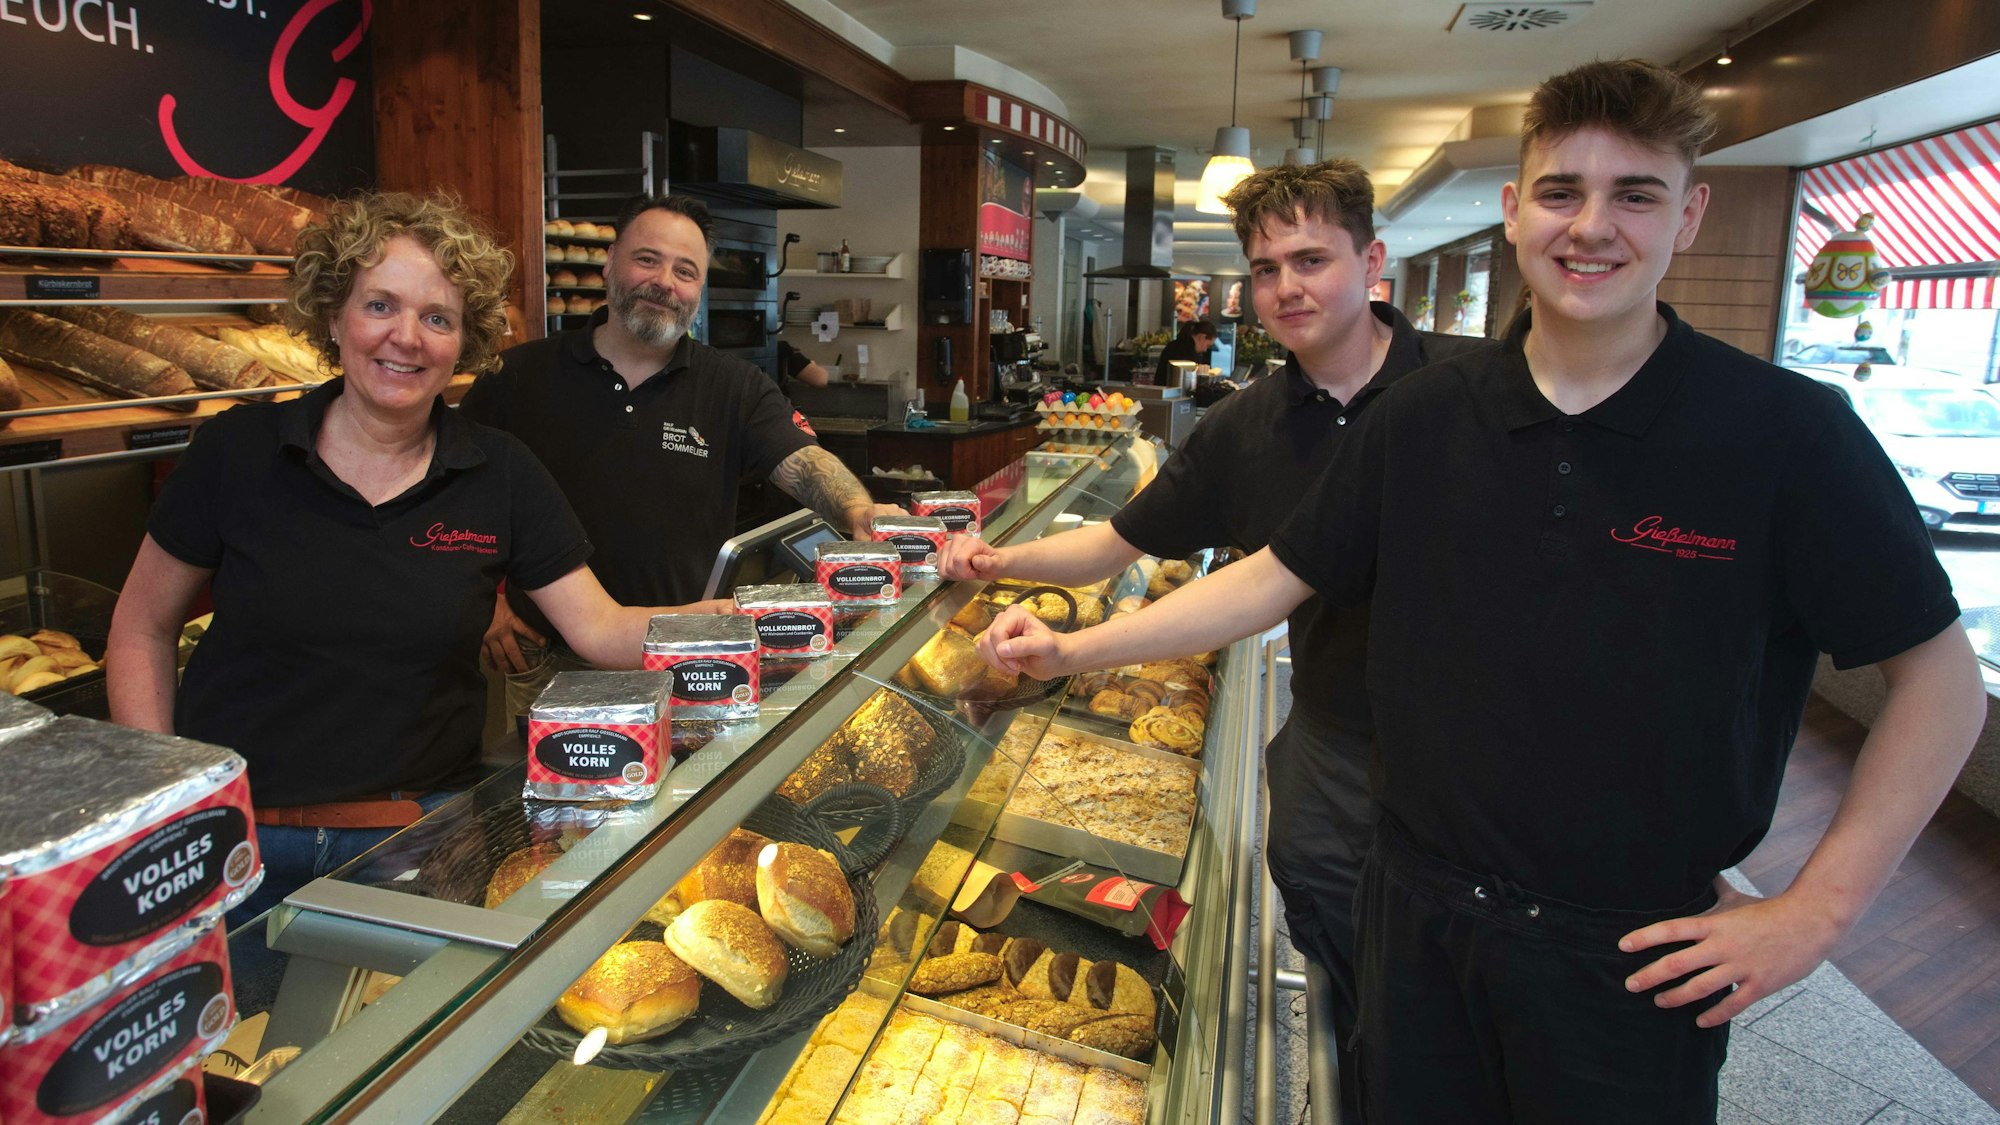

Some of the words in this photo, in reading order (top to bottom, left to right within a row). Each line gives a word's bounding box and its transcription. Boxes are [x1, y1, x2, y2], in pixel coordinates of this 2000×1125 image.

[663, 432, 686, 443] BROT
[662, 441, 709, 458] SOMMELIER
[410, 522, 497, 547] Gießelmann
[1611, 516, 1737, 550] Gießelmann
[1675, 549, 1697, 559] 1925
[758, 624, 816, 632] VOLLKORNBROT
[682, 671, 727, 681] VOLLES
[687, 682, 721, 692] KORN
[562, 743, 617, 755] VOLLES
[569, 756, 610, 768] KORN
[626, 771, 644, 779] GOLD
[122, 832, 213, 896] VOLLES
[229, 853, 251, 880] GOLD
[136, 860, 205, 915] KORN
[92, 990, 188, 1064] VOLLES
[106, 1019, 178, 1081] KORN
